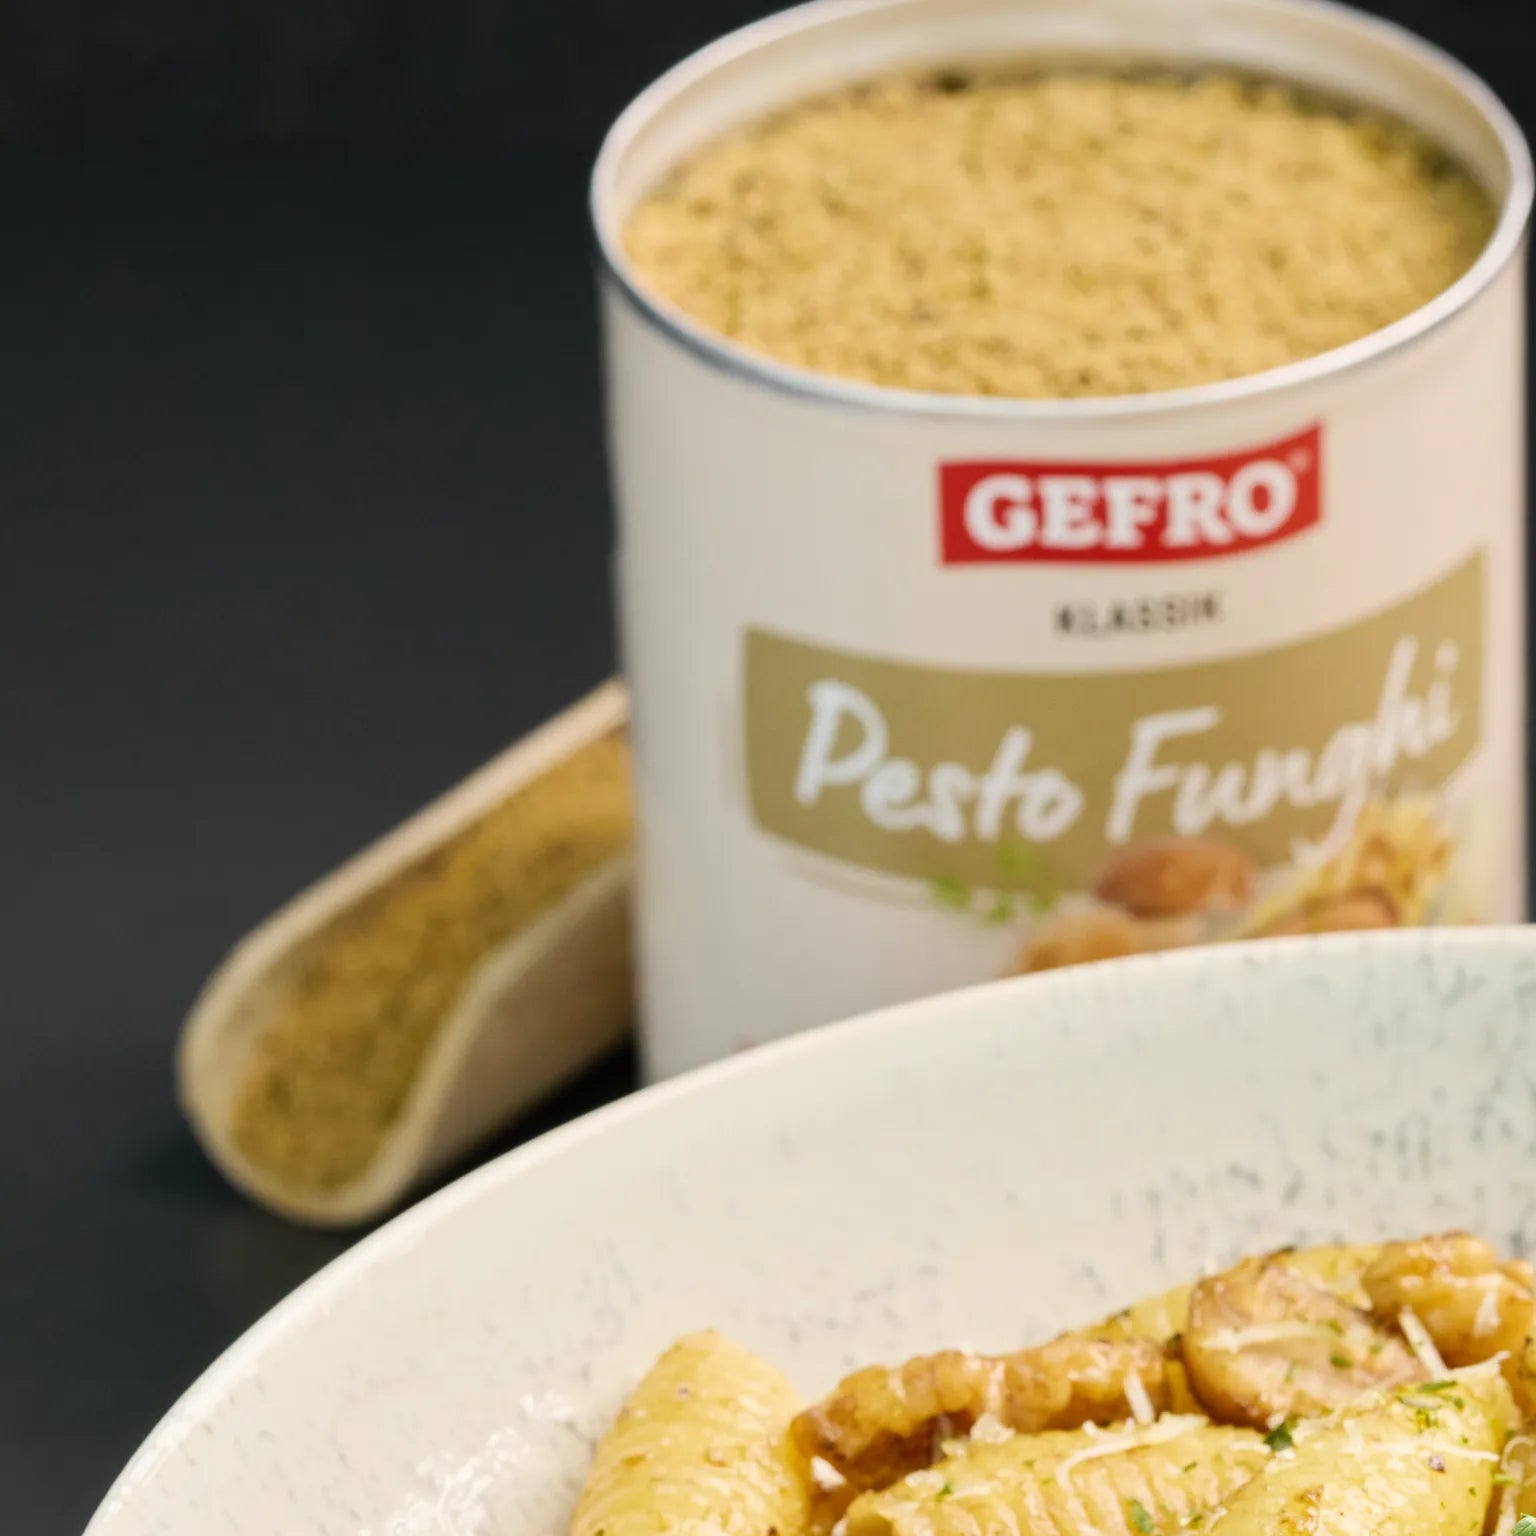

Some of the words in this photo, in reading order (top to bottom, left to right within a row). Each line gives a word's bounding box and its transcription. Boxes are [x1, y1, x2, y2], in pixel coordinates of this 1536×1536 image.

[964, 458, 1298, 551] GEFRO
[1054, 591, 1223, 637] KLASSIK
[795, 679, 1081, 840] Pesto
[1106, 636, 1460, 867] Funghi
